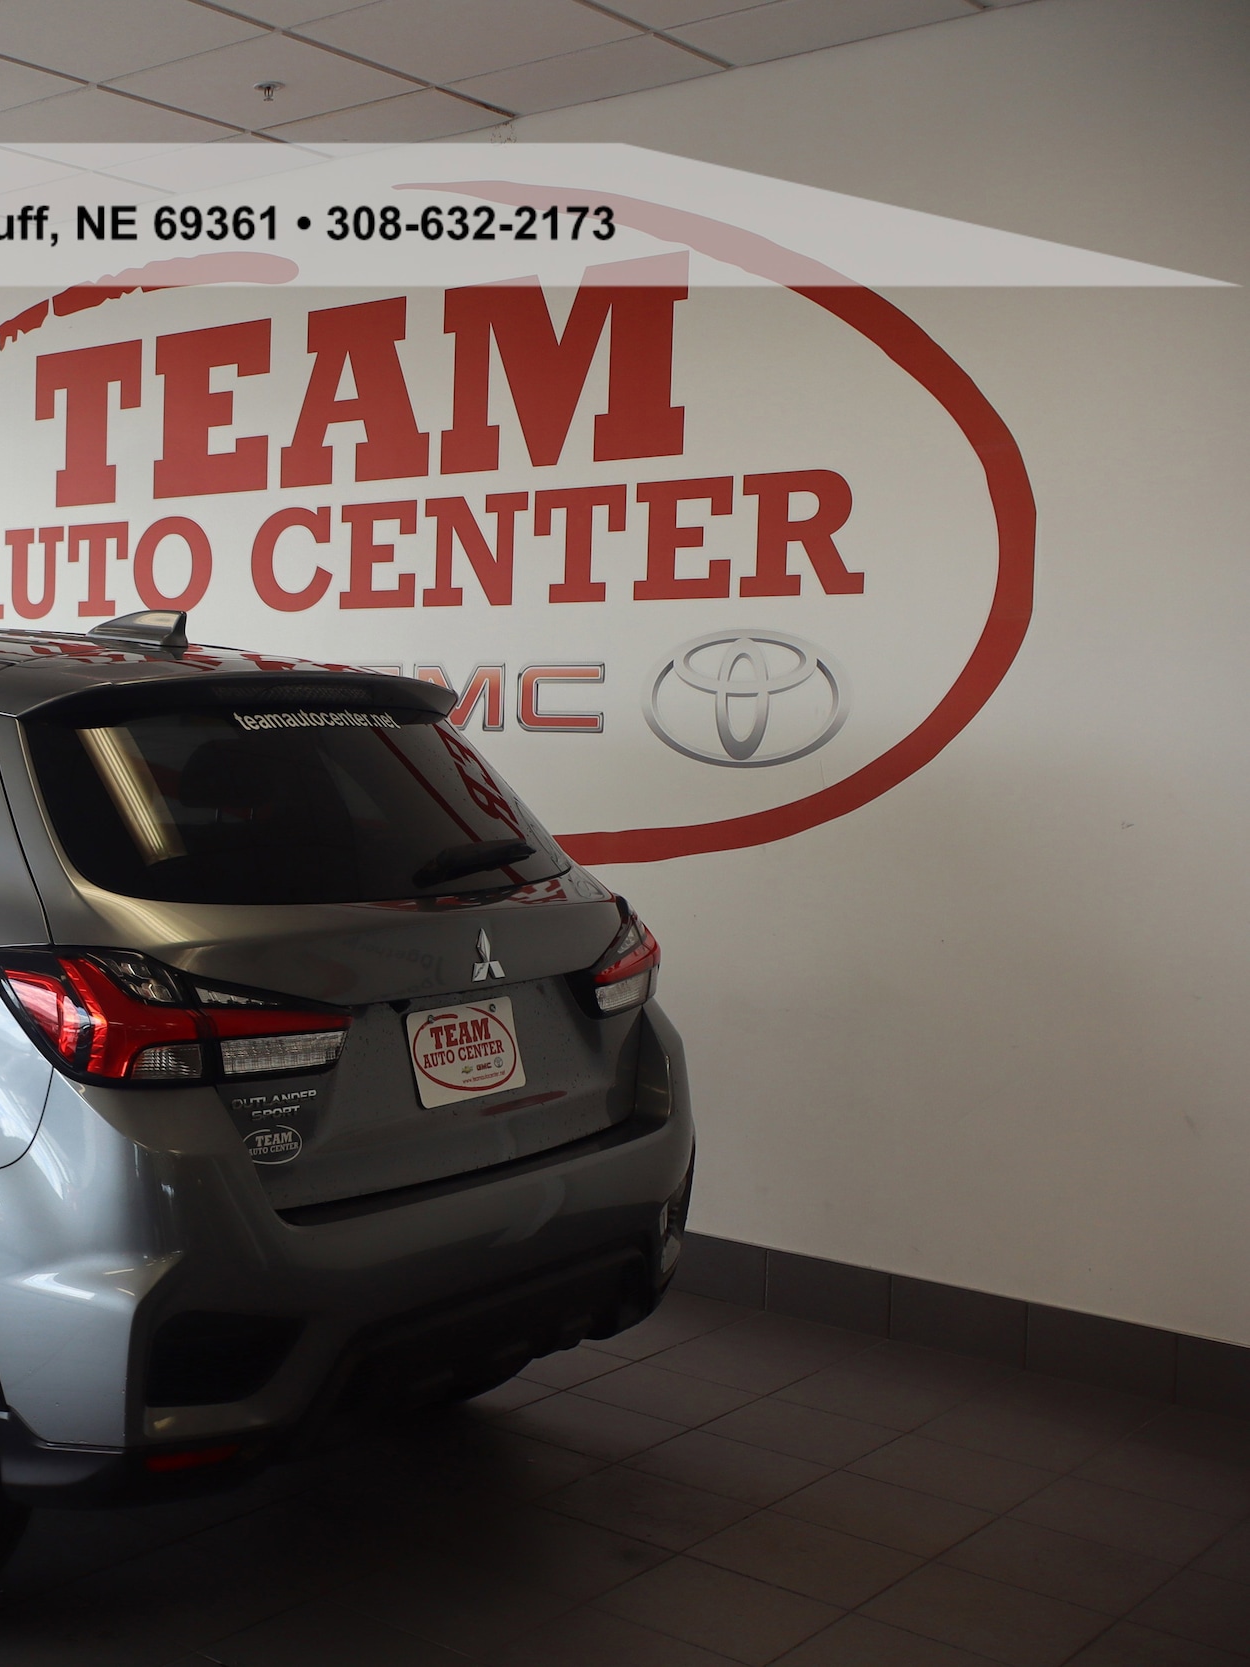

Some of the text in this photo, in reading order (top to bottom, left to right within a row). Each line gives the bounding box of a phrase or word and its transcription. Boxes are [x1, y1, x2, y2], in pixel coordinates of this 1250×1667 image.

[36, 250, 690, 508] TEAM
[250, 468, 865, 613] CENTER
[358, 663, 605, 733] MC
[233, 709, 401, 730] teamautocenter.net
[430, 1017, 491, 1050] TEAM
[423, 1039, 505, 1069] AUTO CENTER
[231, 1089, 317, 1110] OUTLANDER
[251, 1105, 301, 1121] SPORT
[255, 1131, 293, 1147] TEAM
[270, 1141, 299, 1153] CENTER
